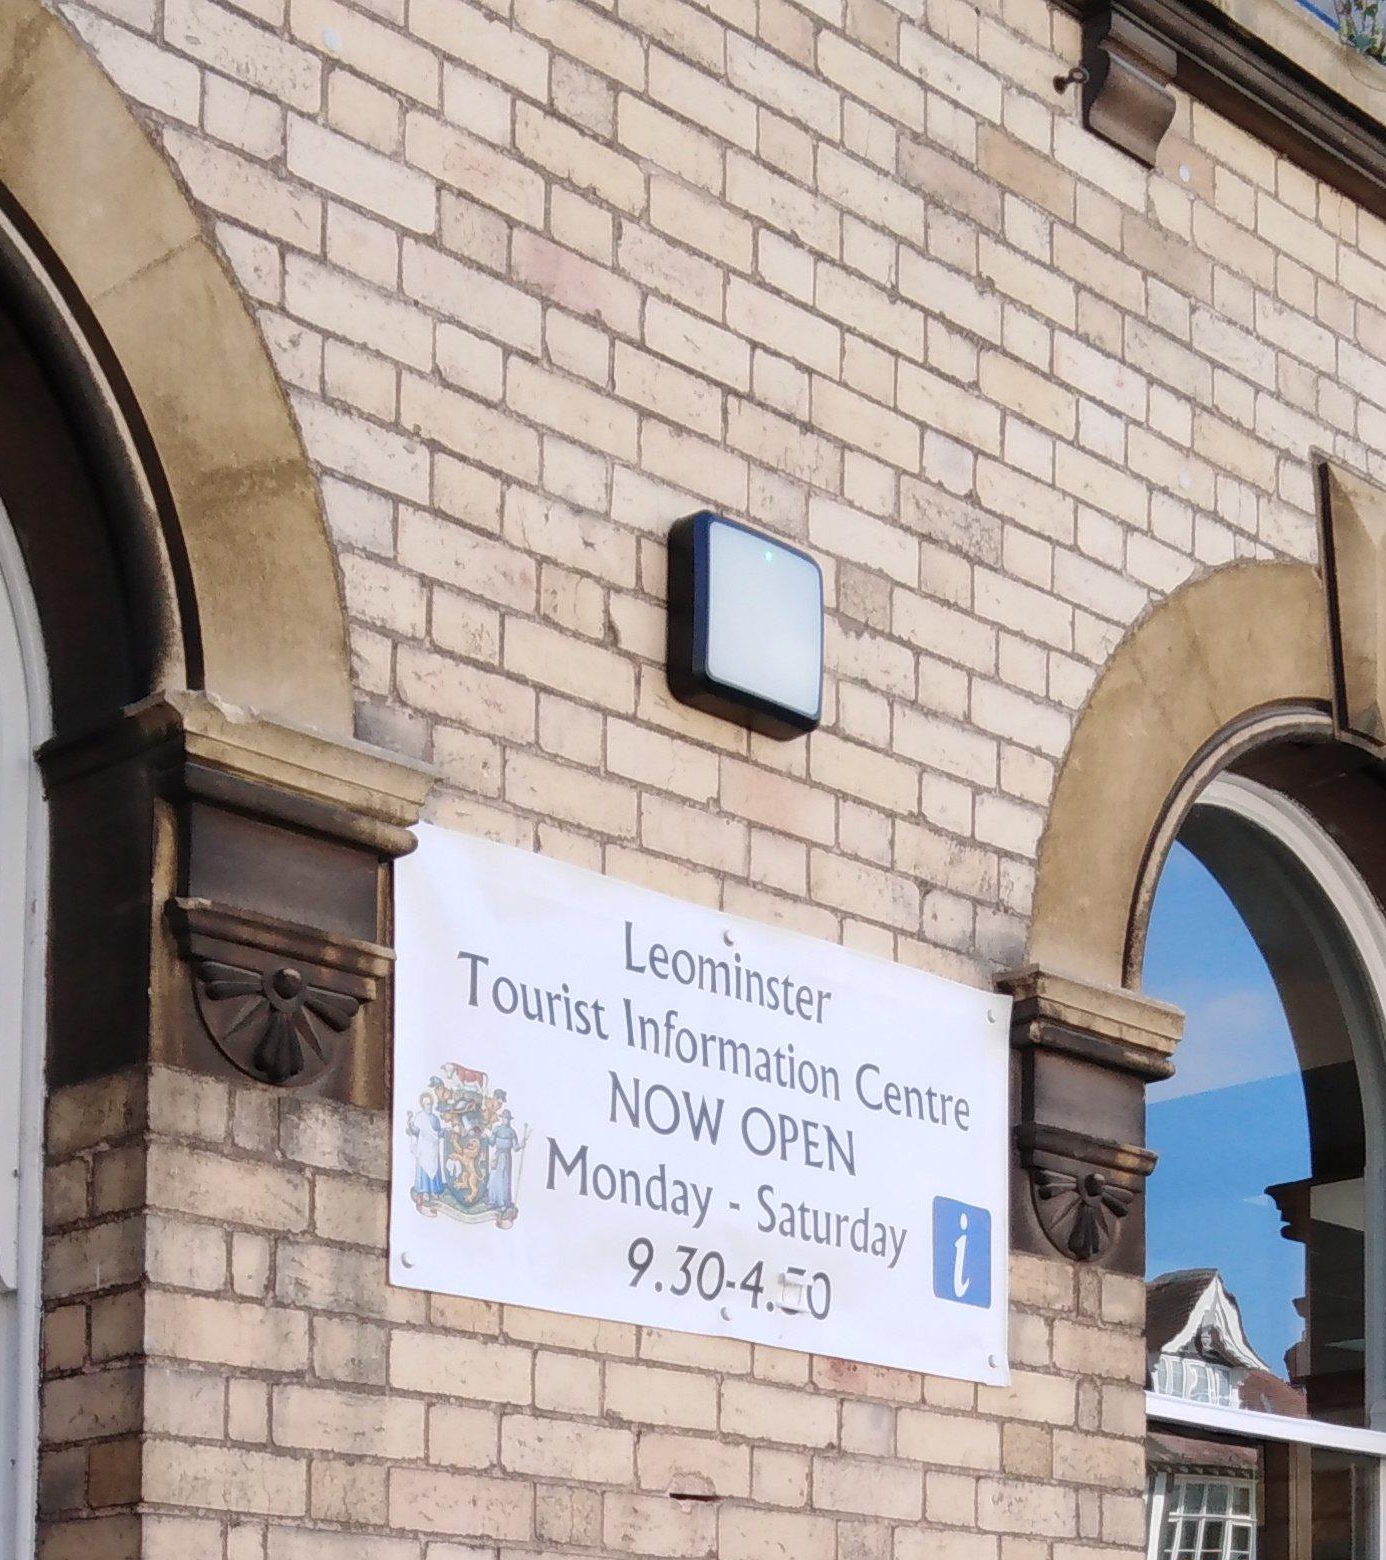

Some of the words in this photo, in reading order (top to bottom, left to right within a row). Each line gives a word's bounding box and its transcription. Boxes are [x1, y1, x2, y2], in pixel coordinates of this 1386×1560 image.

[624, 921, 832, 1024] Leominster
[457, 951, 609, 1041] Tourist
[622, 998, 841, 1101] Information
[855, 1063, 971, 1132] Centre
[608, 1070, 725, 1146] NOW
[741, 1107, 857, 1176] OPEN
[546, 1136, 713, 1229] Monday
[756, 1184, 908, 1268] Saturday
